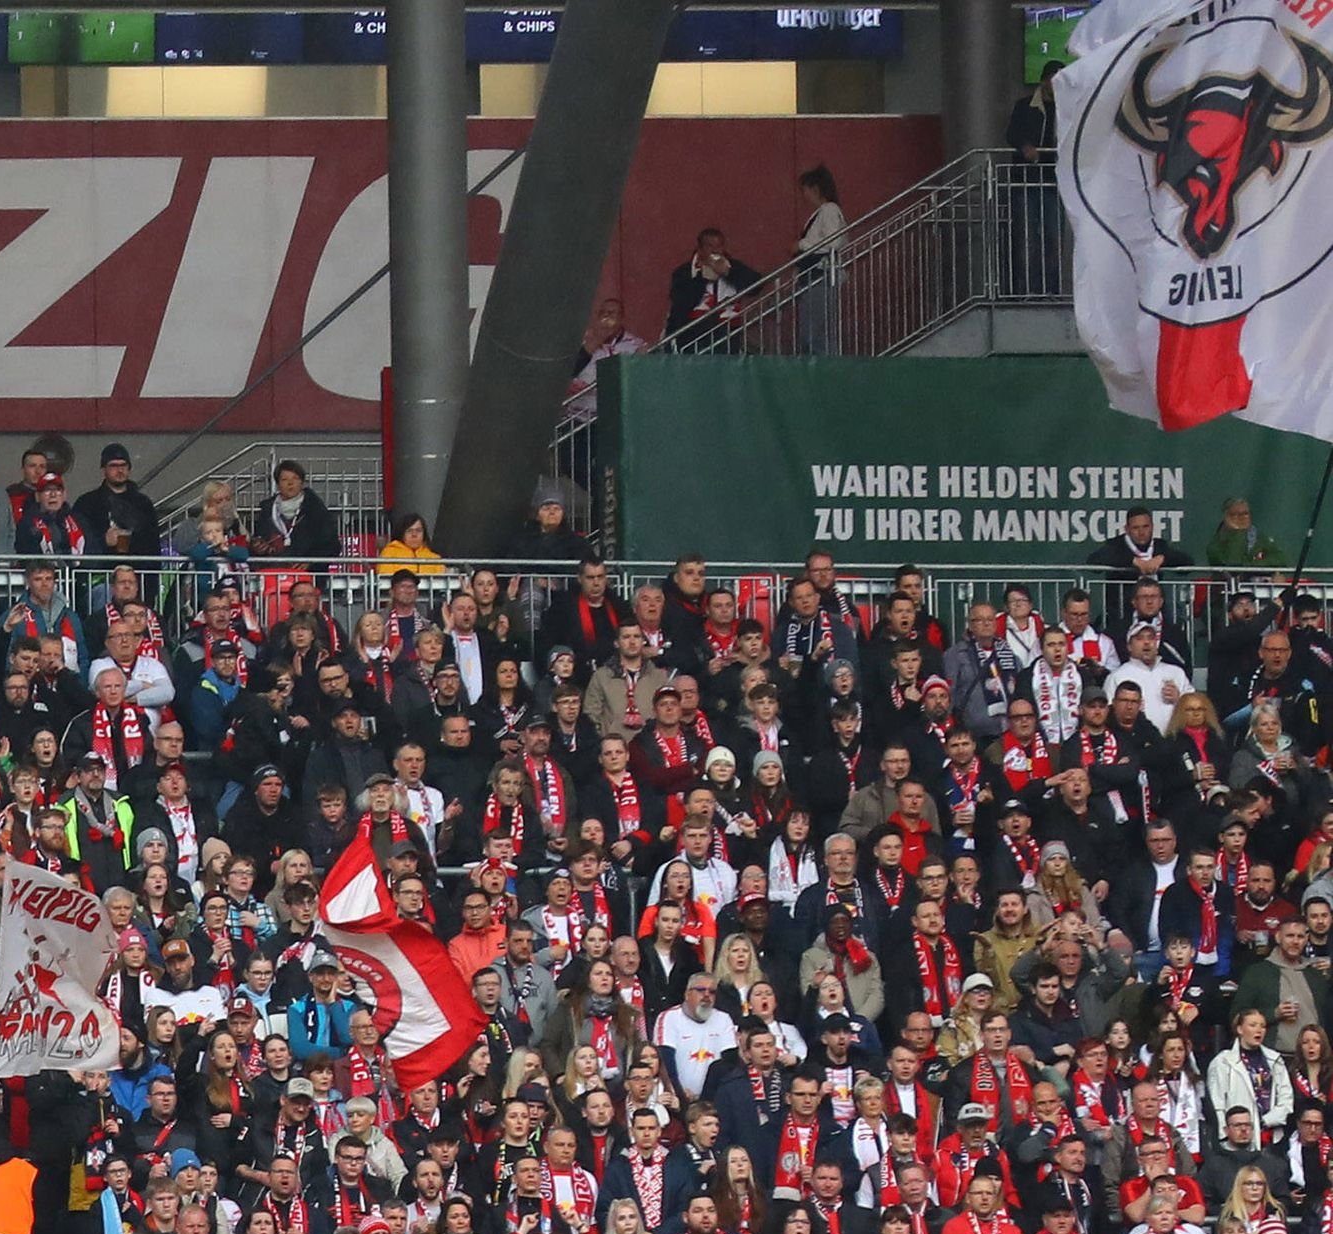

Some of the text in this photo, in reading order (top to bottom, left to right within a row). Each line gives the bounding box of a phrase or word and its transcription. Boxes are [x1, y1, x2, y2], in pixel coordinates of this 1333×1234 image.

[515, 21, 555, 33] CHIPS
[812, 466, 1184, 499] WAHRE HELDEN STEHEN
[814, 508, 1184, 541] ZU IHRER MANNSCHFT
